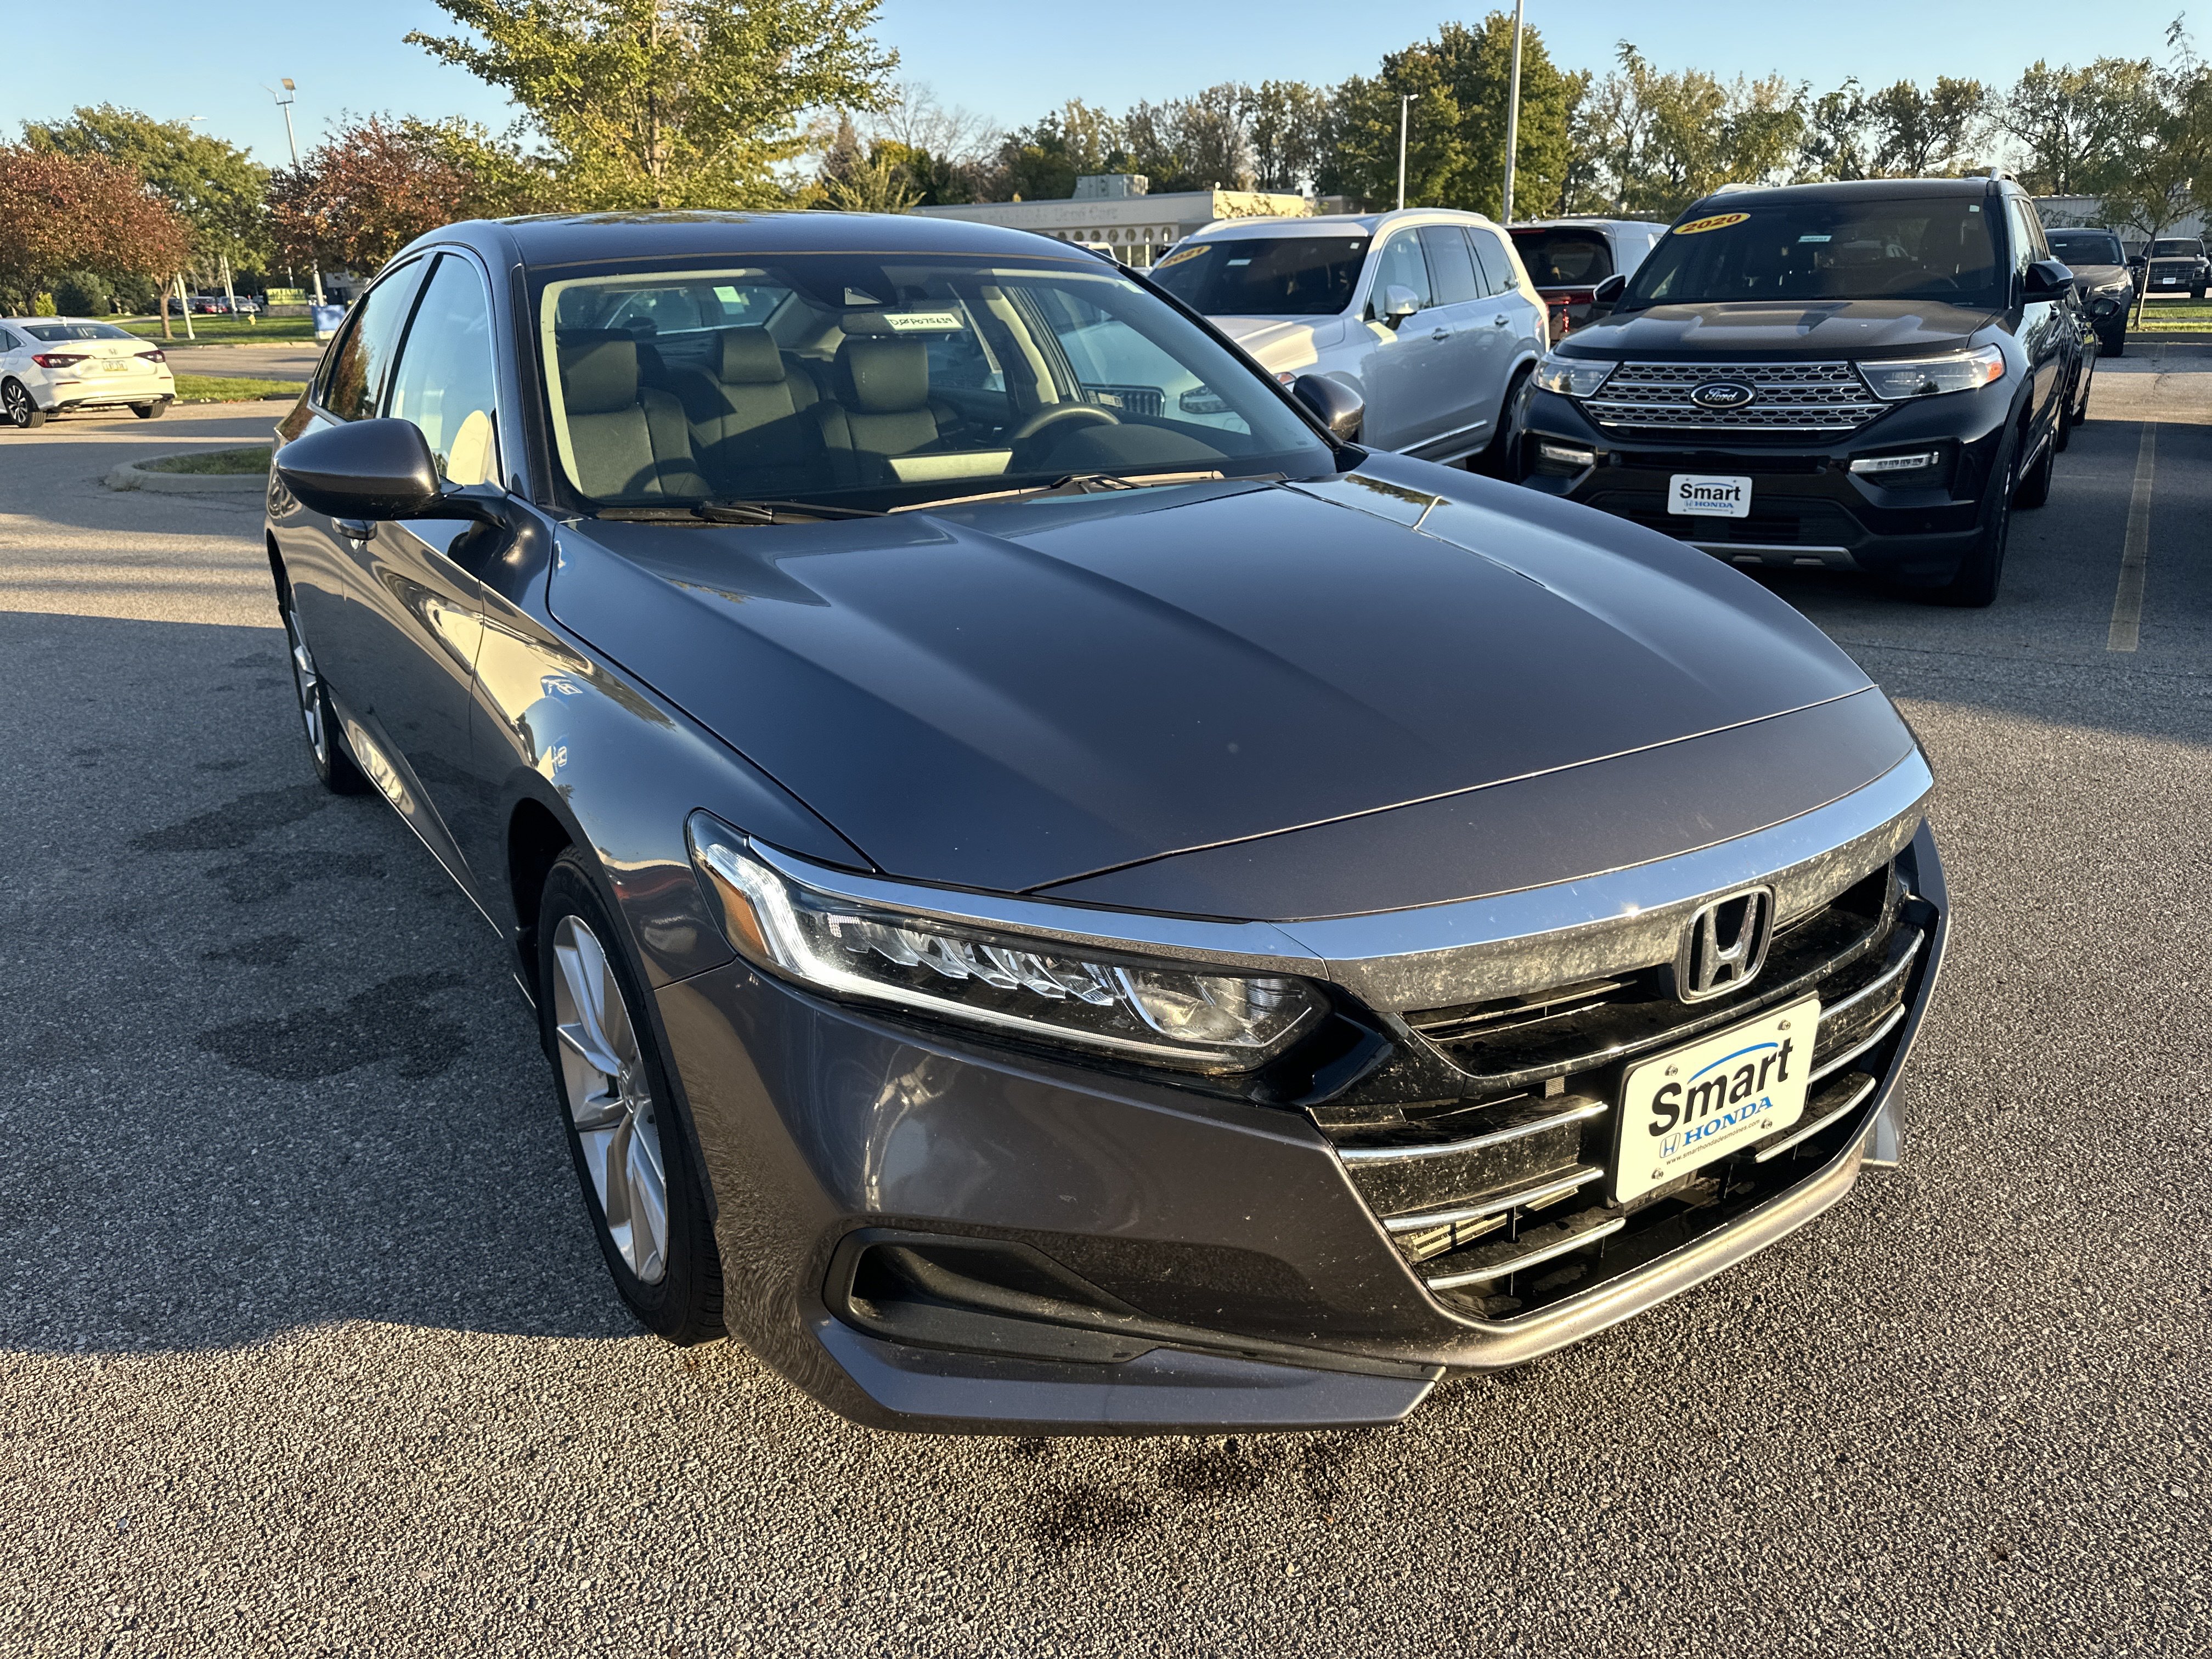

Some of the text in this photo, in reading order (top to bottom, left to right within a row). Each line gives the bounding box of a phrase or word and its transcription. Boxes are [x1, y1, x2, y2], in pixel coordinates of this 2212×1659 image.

[1681, 215, 1741, 233] 2020
[1705, 387, 1739, 402] Ford
[1679, 483, 1741, 501] Smart
[1649, 1037, 1793, 1137] Smart
[1683, 1096, 1773, 1147] HONDA
[1666, 1120, 1760, 1165] www.smarthondadesmoines.com
